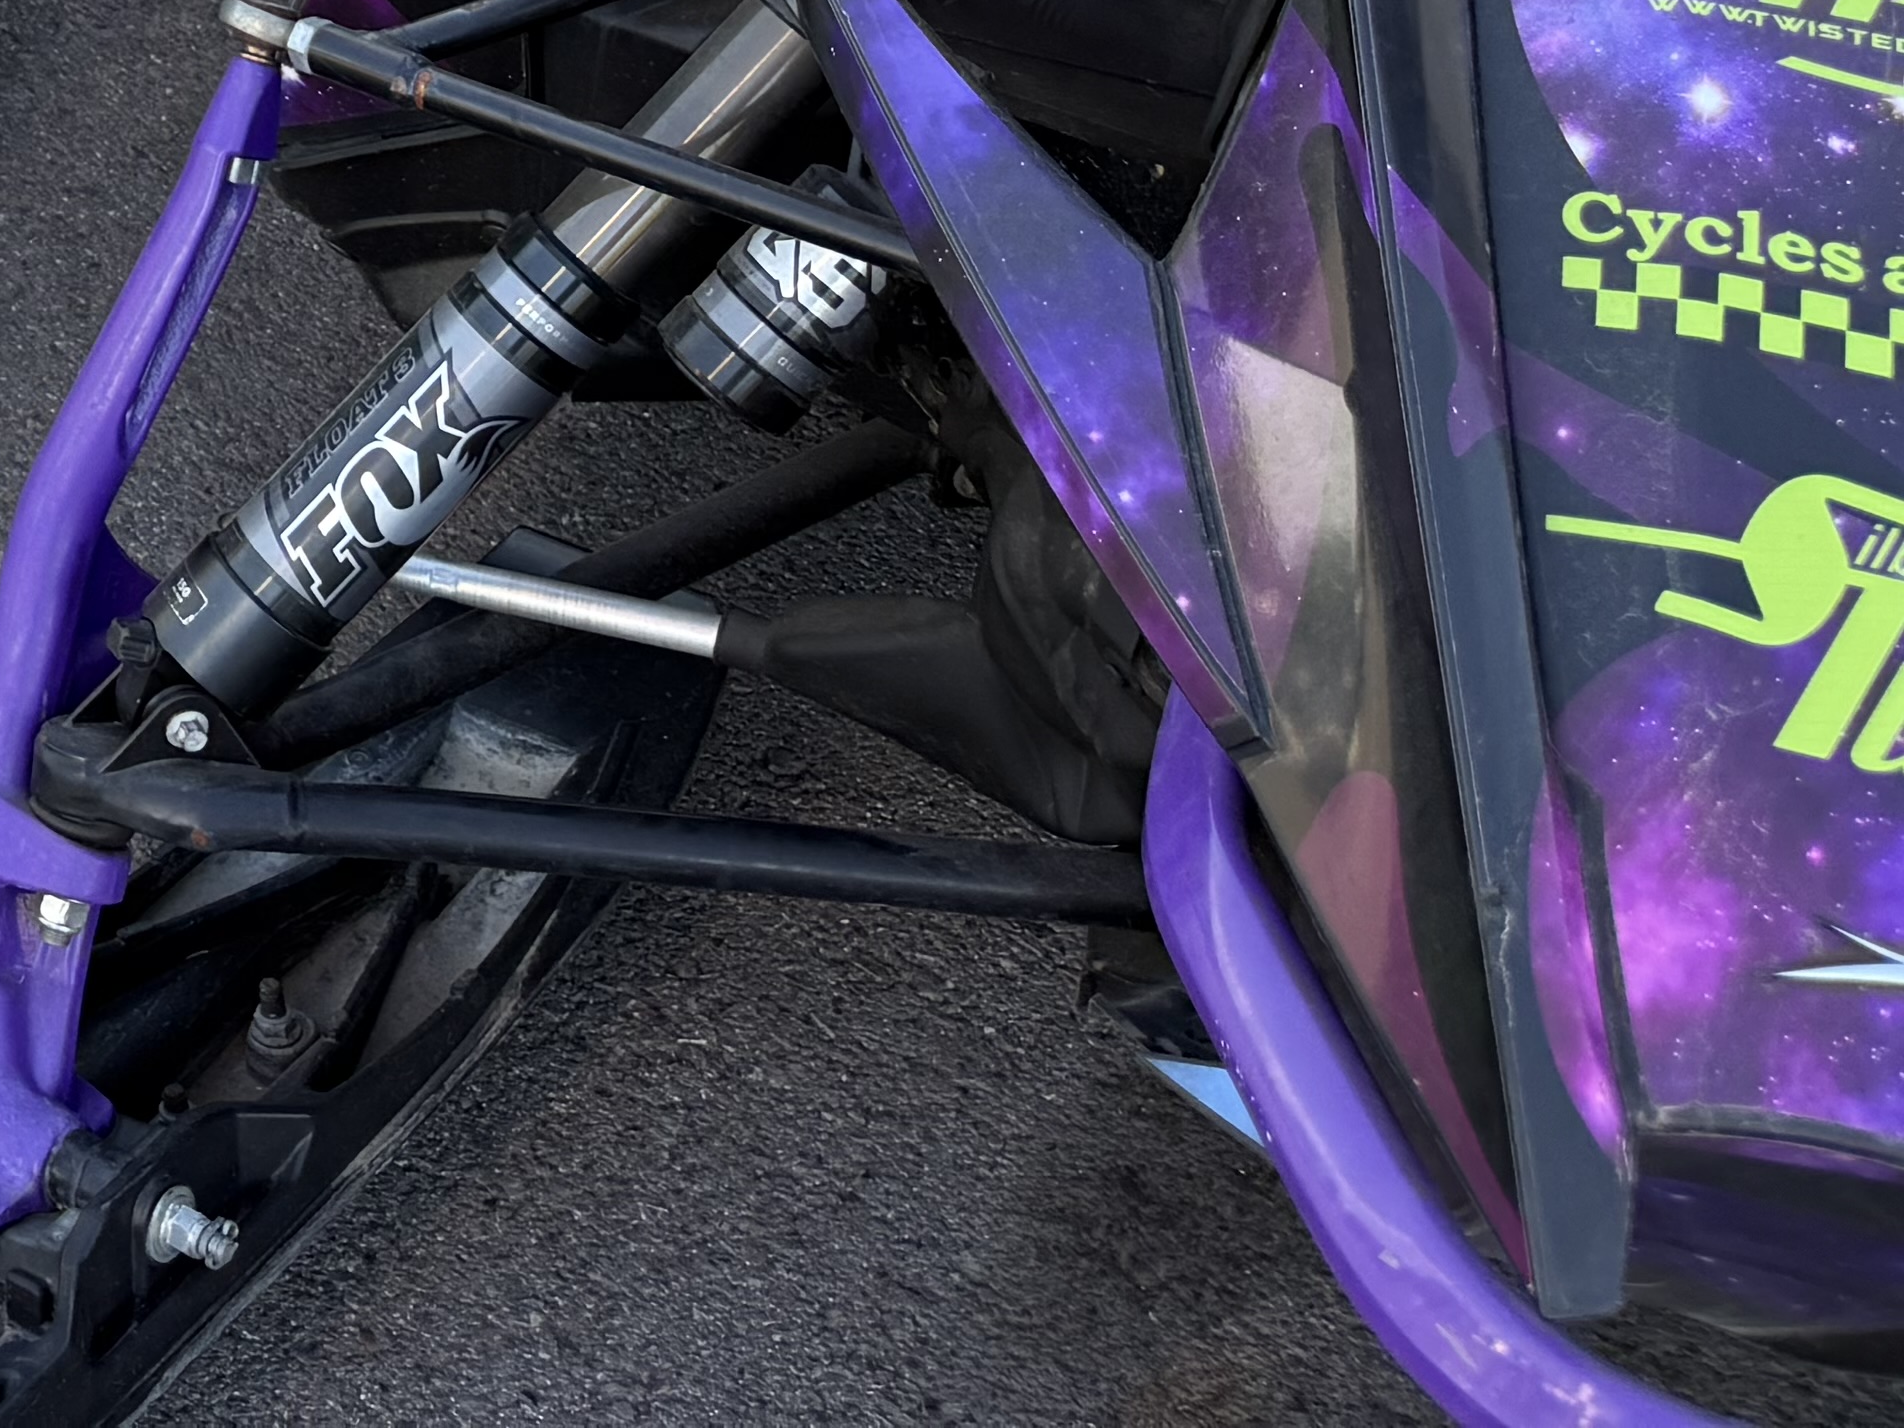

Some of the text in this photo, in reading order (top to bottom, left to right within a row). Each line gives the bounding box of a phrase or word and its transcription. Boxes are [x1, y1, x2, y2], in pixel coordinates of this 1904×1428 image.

[1561, 191, 1865, 284] Cycles
[280, 358, 482, 609] FOX
[283, 346, 417, 500] FLOAT 3
